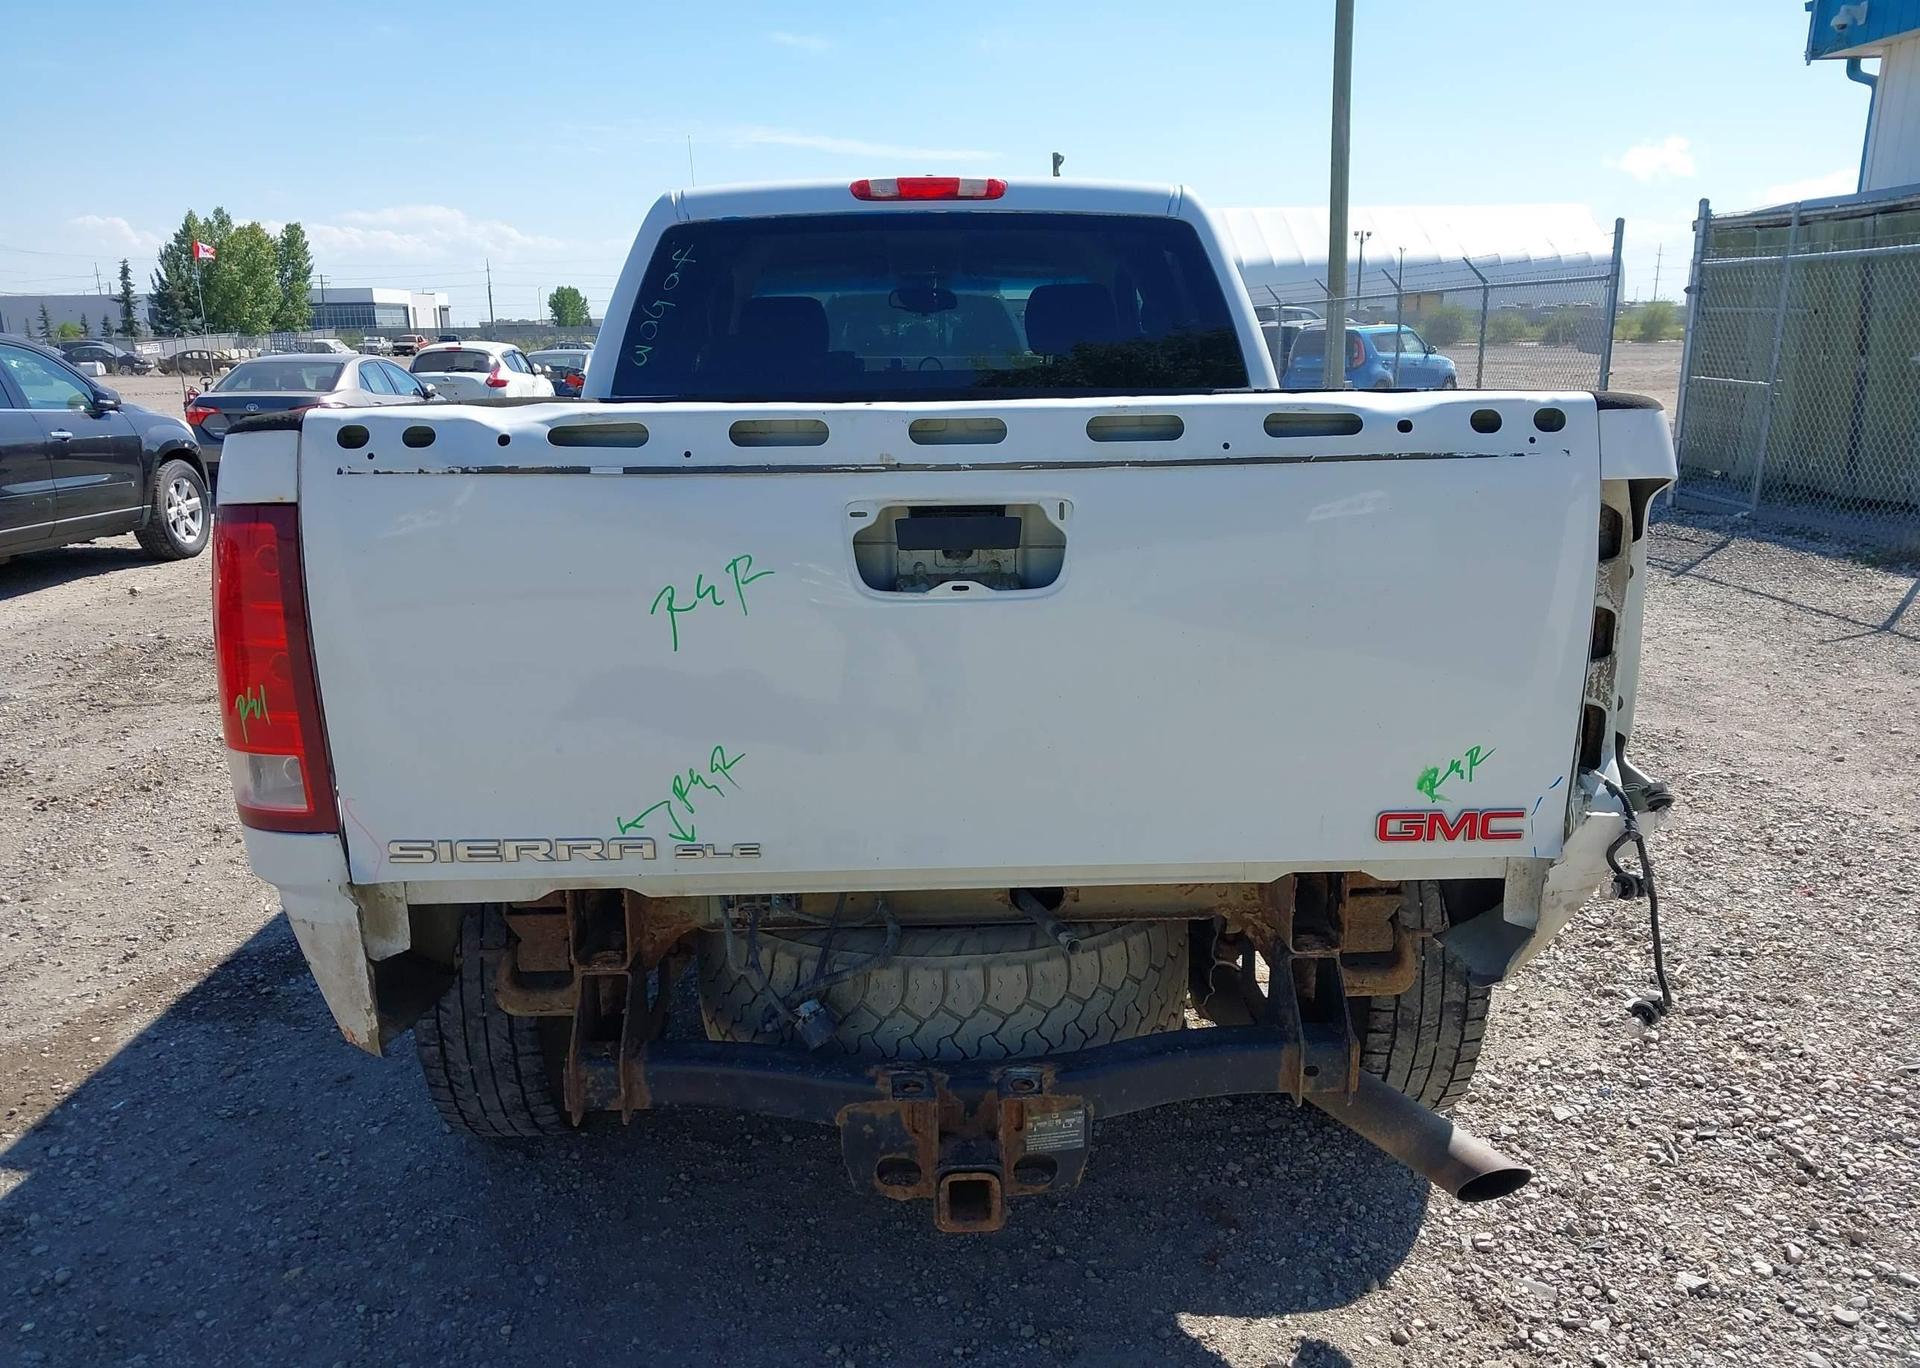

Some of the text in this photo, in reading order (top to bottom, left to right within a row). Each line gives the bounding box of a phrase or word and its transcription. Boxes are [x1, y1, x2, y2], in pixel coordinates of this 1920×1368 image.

[1376, 808, 1526, 842] GMC
[387, 837, 762, 863] SIERRA SLE
